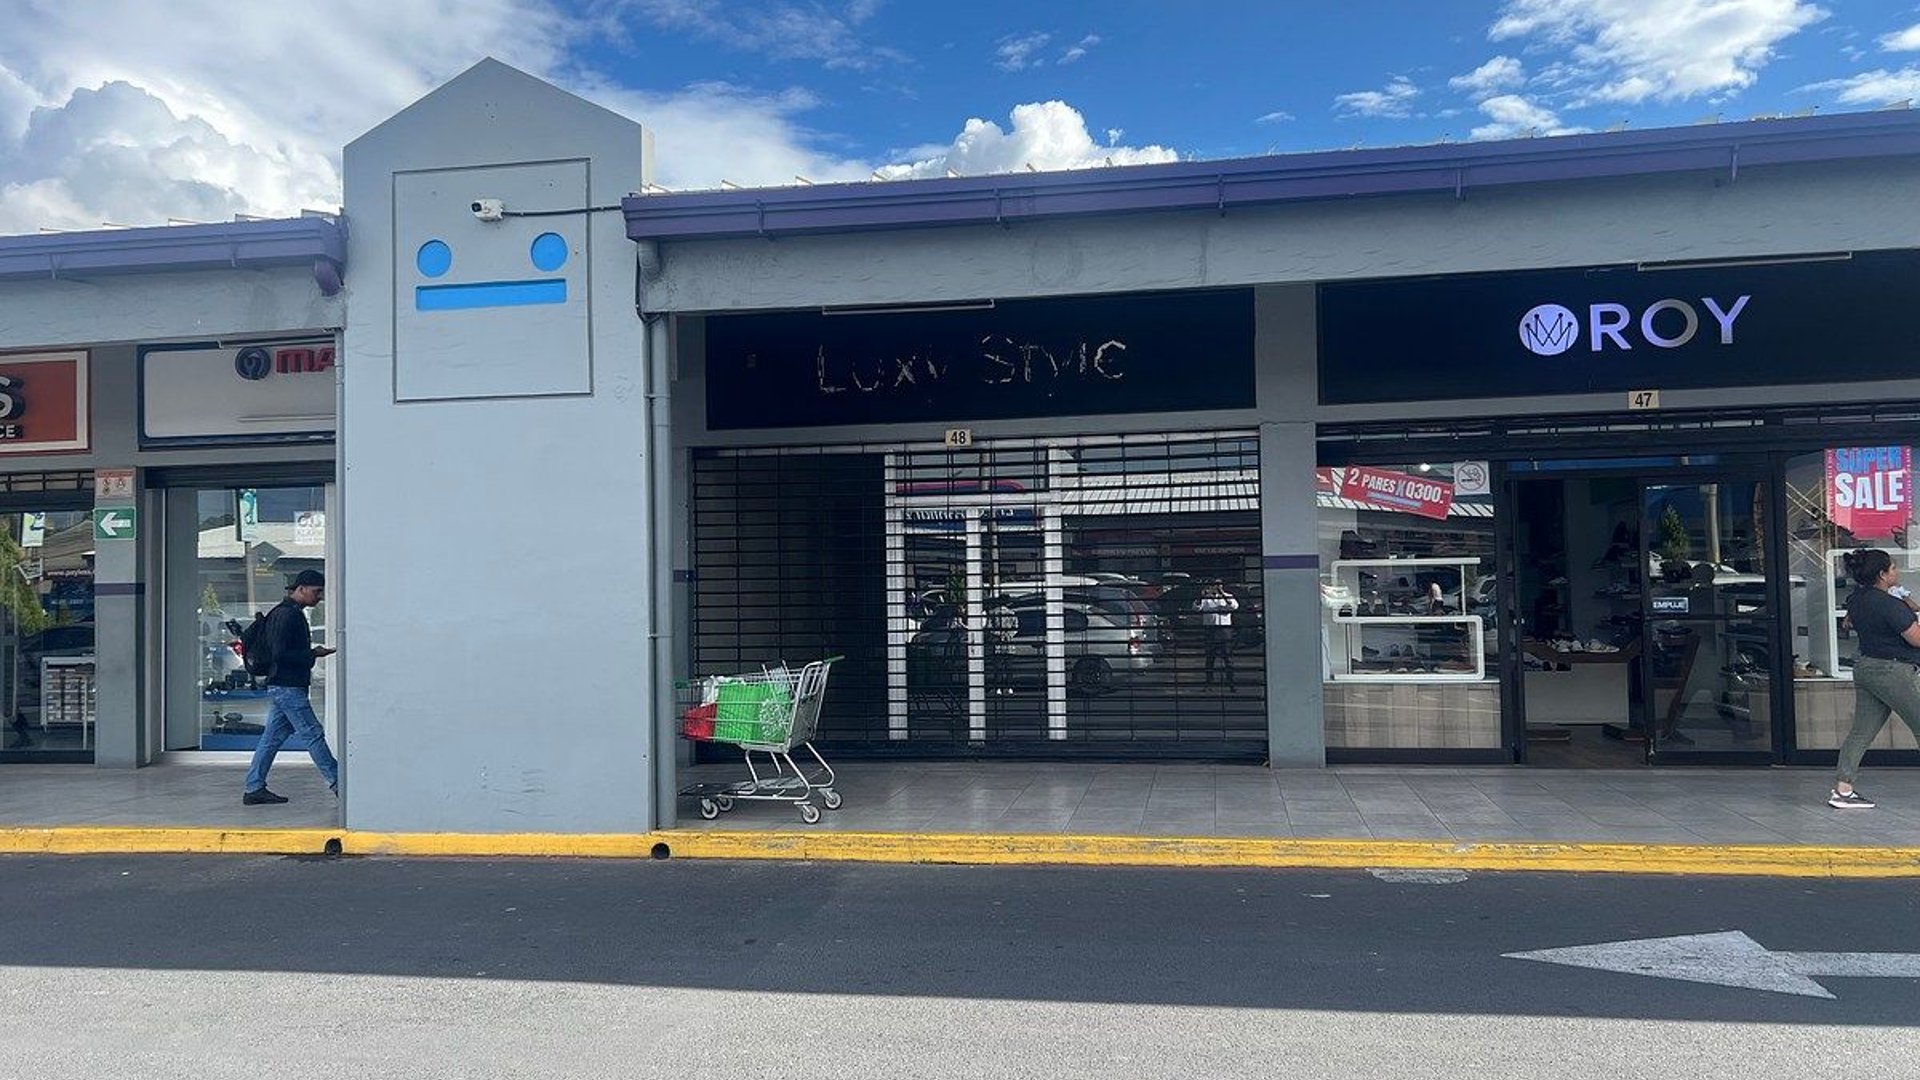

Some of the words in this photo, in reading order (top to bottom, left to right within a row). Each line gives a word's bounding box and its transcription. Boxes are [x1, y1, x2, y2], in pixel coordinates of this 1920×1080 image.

[1590, 295, 1751, 351] ROY
[1635, 393, 1652, 407] 47
[950, 430, 966, 445] 48
[1835, 447, 1902, 474] SUPER
[1347, 467, 1360, 486] 2
[1361, 474, 1396, 493] PARES
[1395, 480, 1407, 496] X
[1835, 470, 1905, 512] SALE
